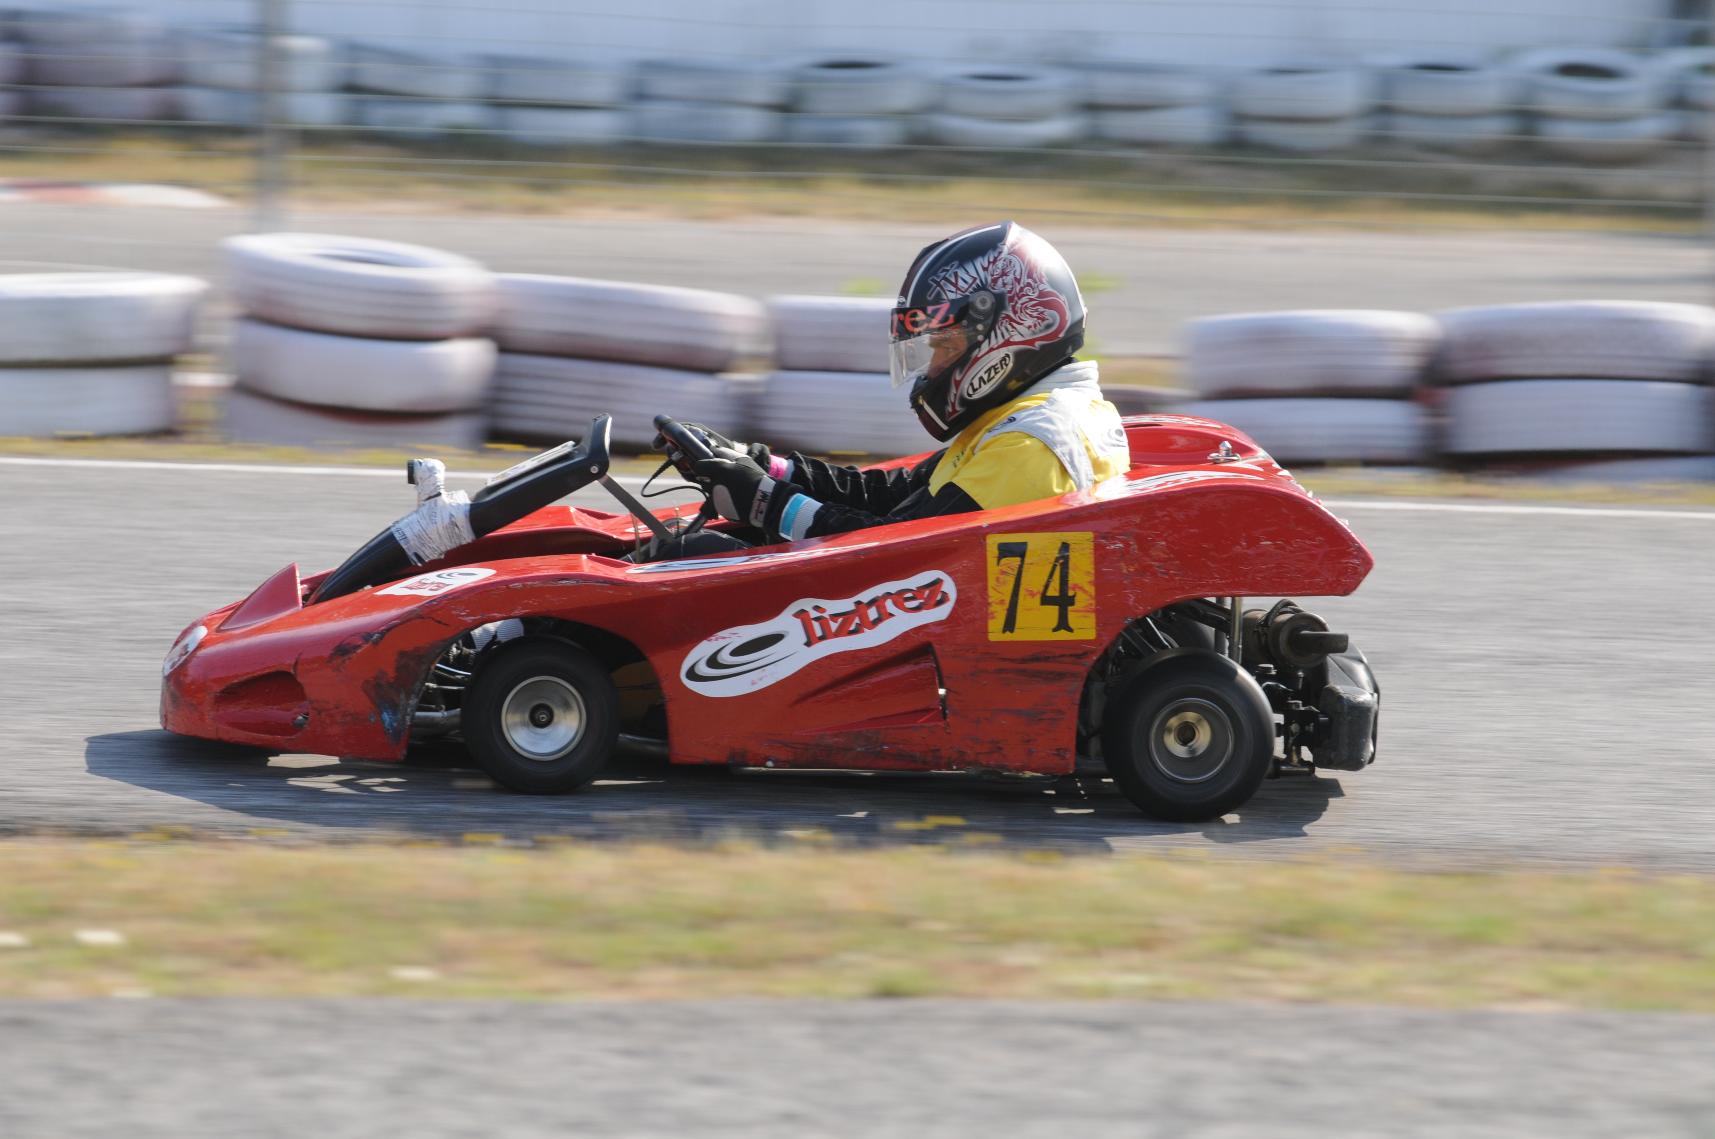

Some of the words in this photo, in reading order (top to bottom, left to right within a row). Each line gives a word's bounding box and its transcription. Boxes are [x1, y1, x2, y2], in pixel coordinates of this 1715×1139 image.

[969, 355, 1009, 393] LAZER
[791, 577, 951, 648] liztrez
[996, 541, 1077, 634] 74
